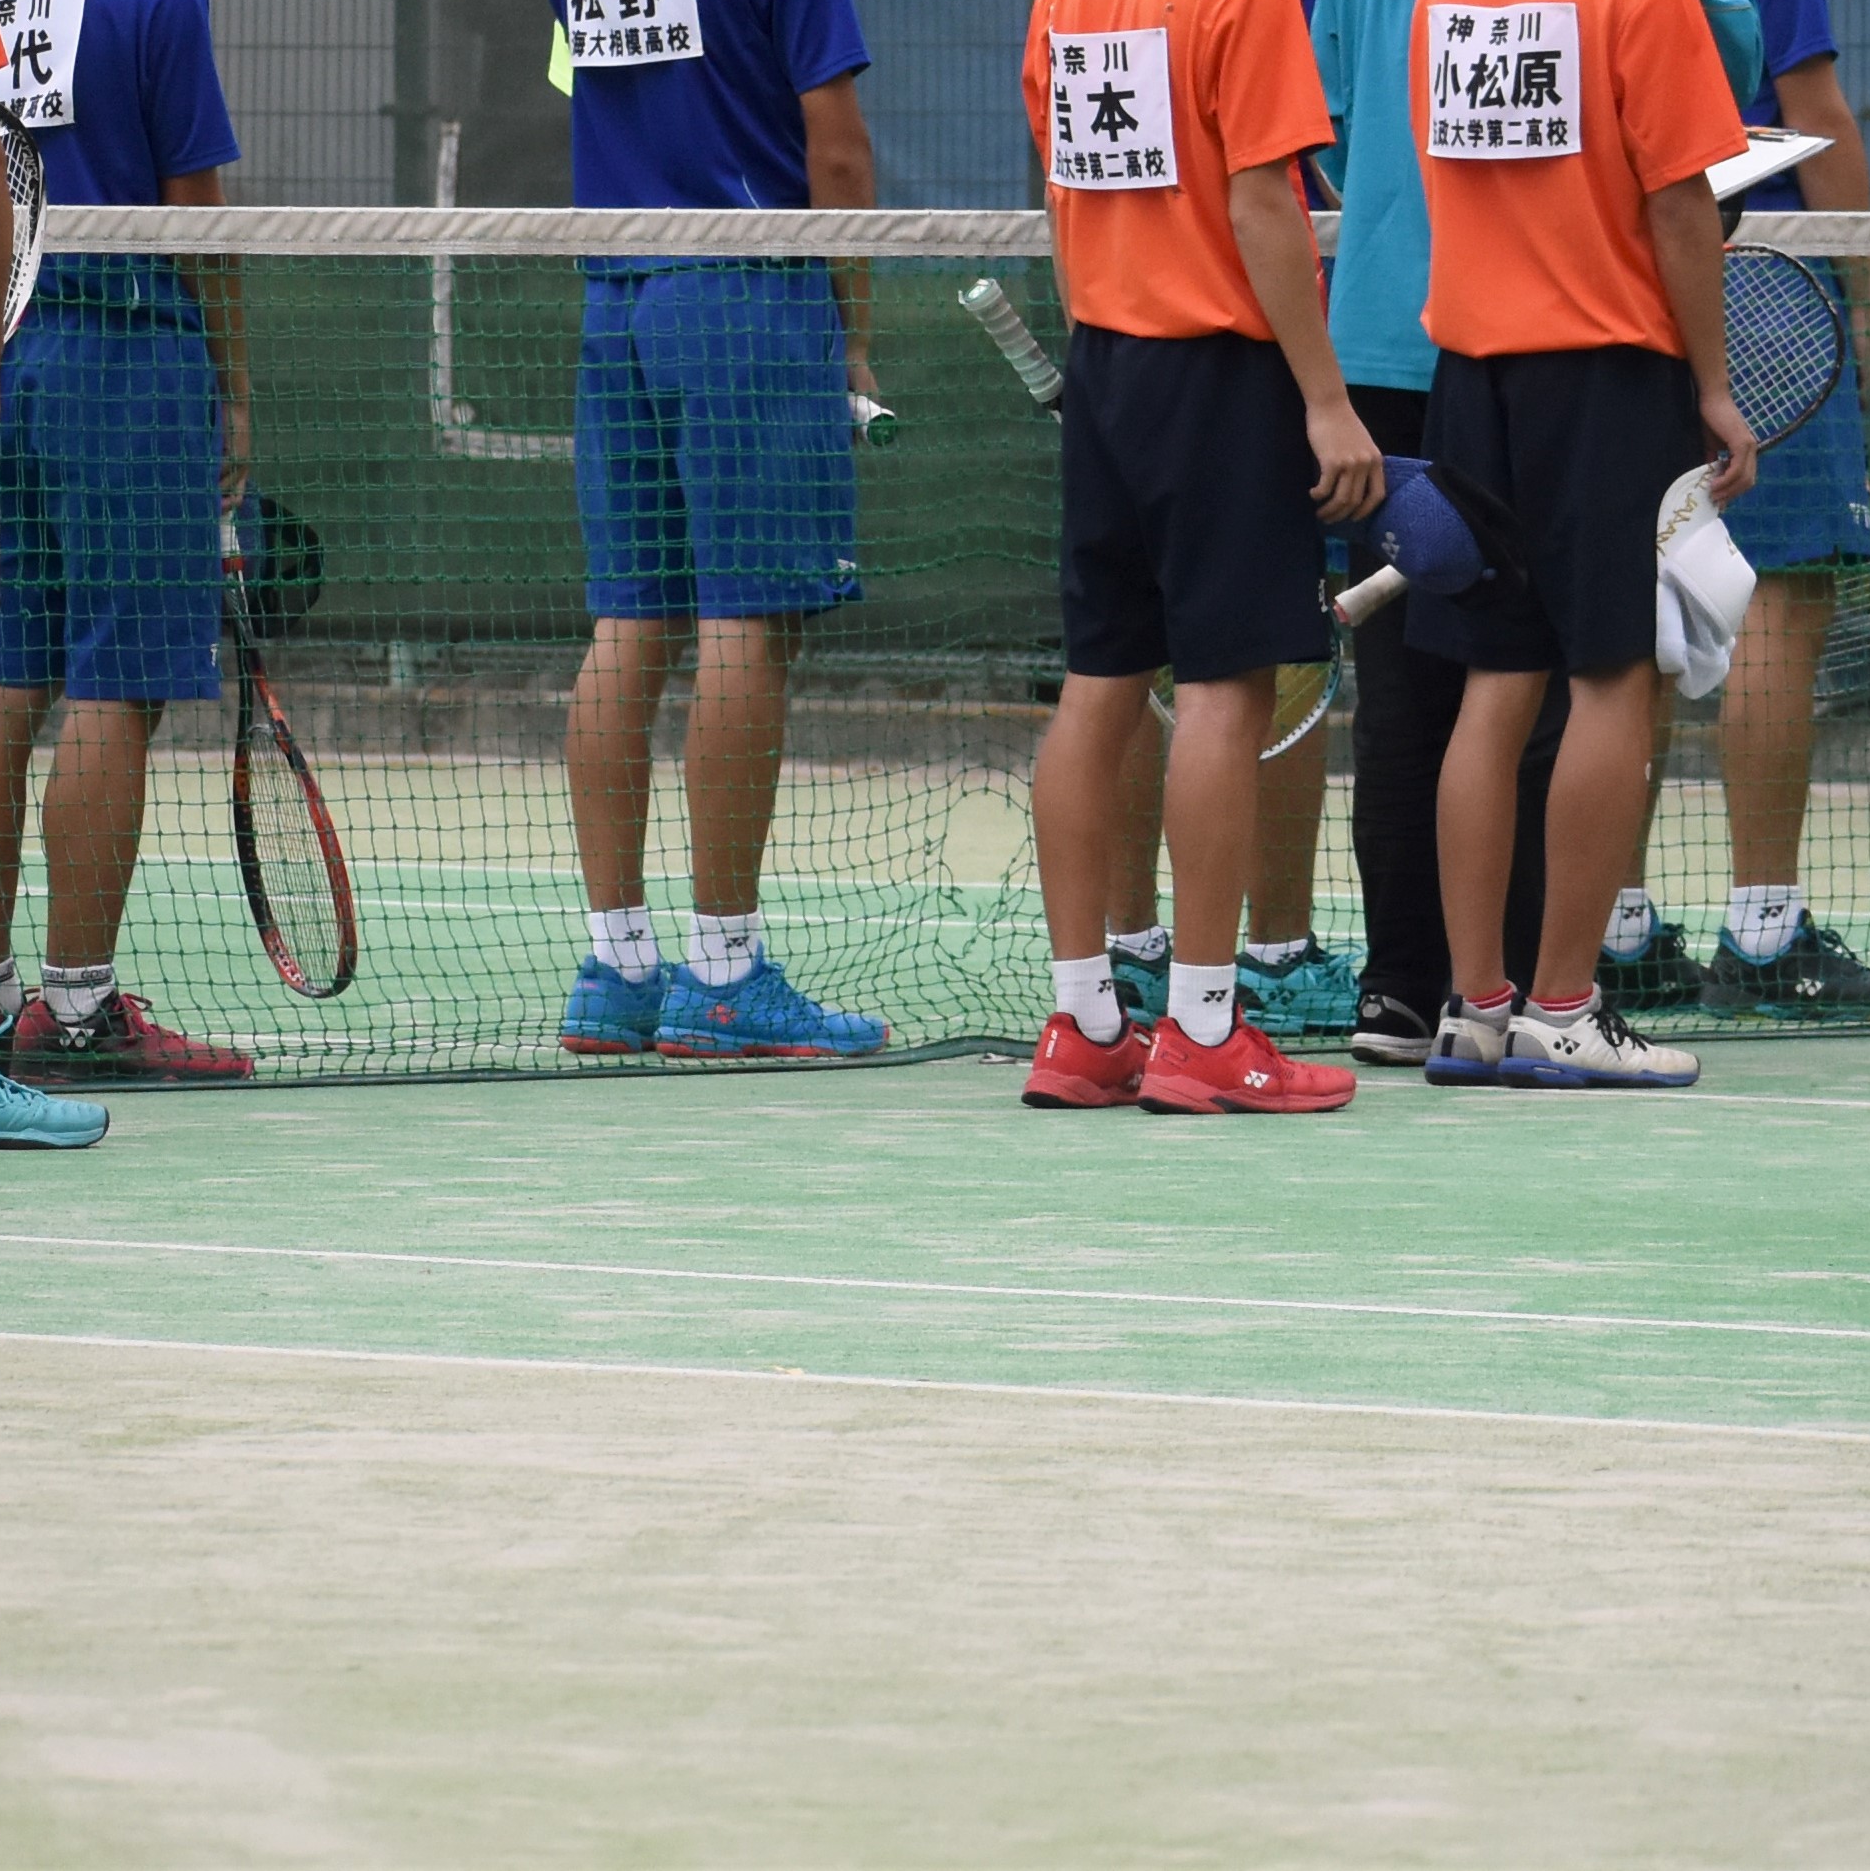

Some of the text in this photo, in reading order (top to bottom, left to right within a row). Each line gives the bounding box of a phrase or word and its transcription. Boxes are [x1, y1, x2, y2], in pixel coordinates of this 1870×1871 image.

[1446, 11, 1542, 45] 神奈川
[10, 28, 54, 90] 代
[1433, 49, 1563, 110] 小松原
